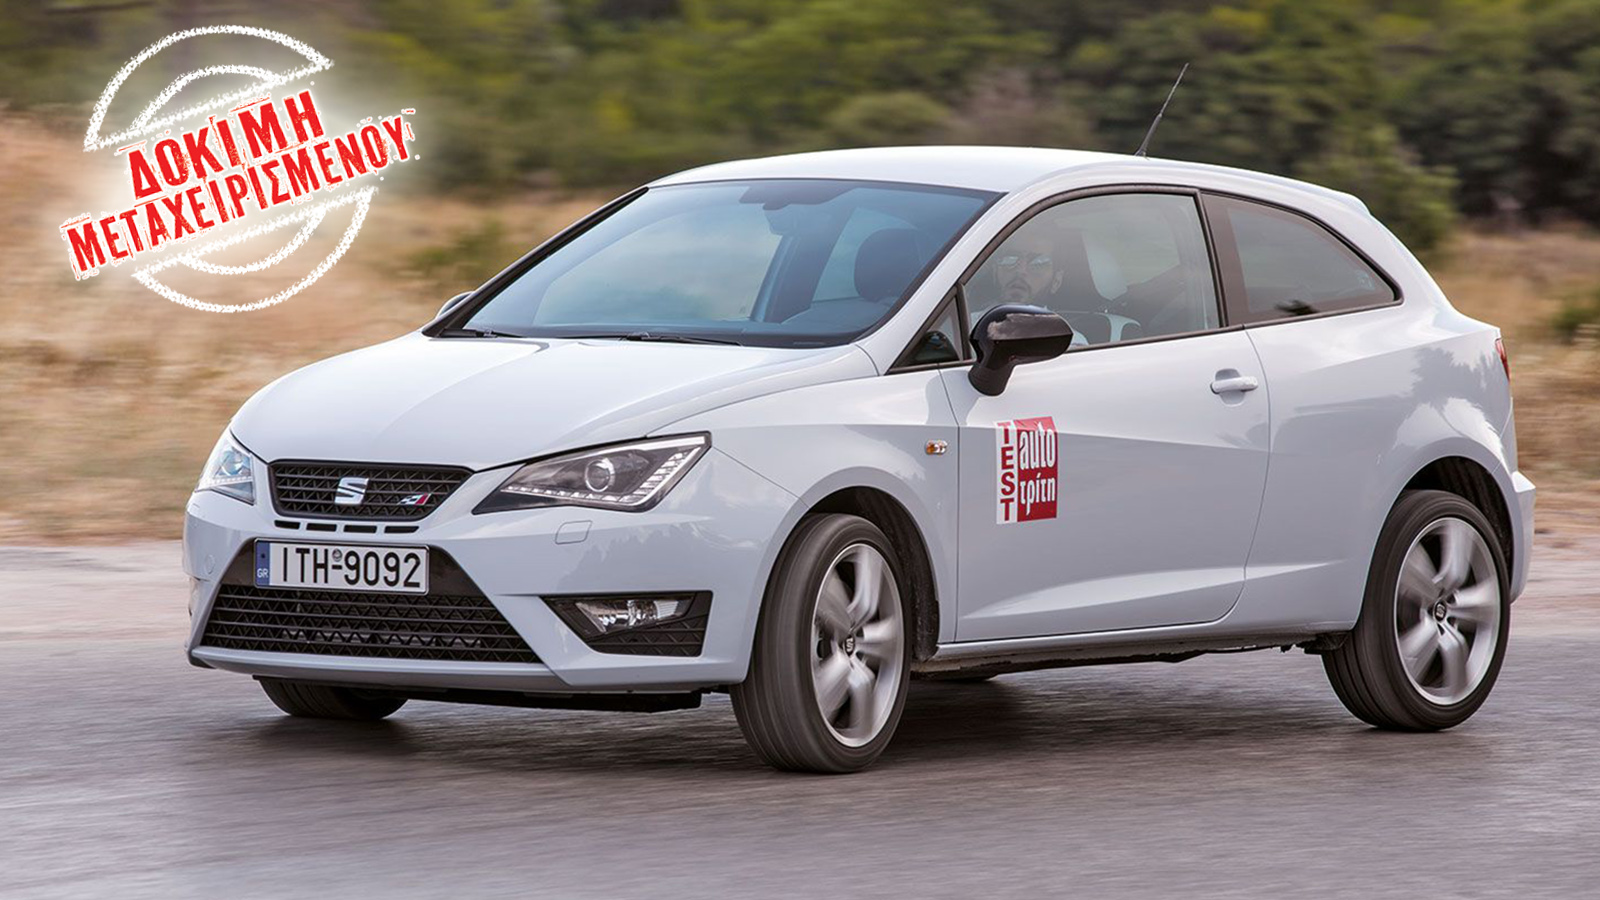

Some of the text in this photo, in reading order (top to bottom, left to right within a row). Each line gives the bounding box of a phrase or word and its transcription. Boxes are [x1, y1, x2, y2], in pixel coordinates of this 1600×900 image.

[1020, 421, 1056, 470] auto
[997, 421, 1016, 521] TEST
[1020, 472, 1056, 516] τρίτη
[256, 568, 269, 578] GR
